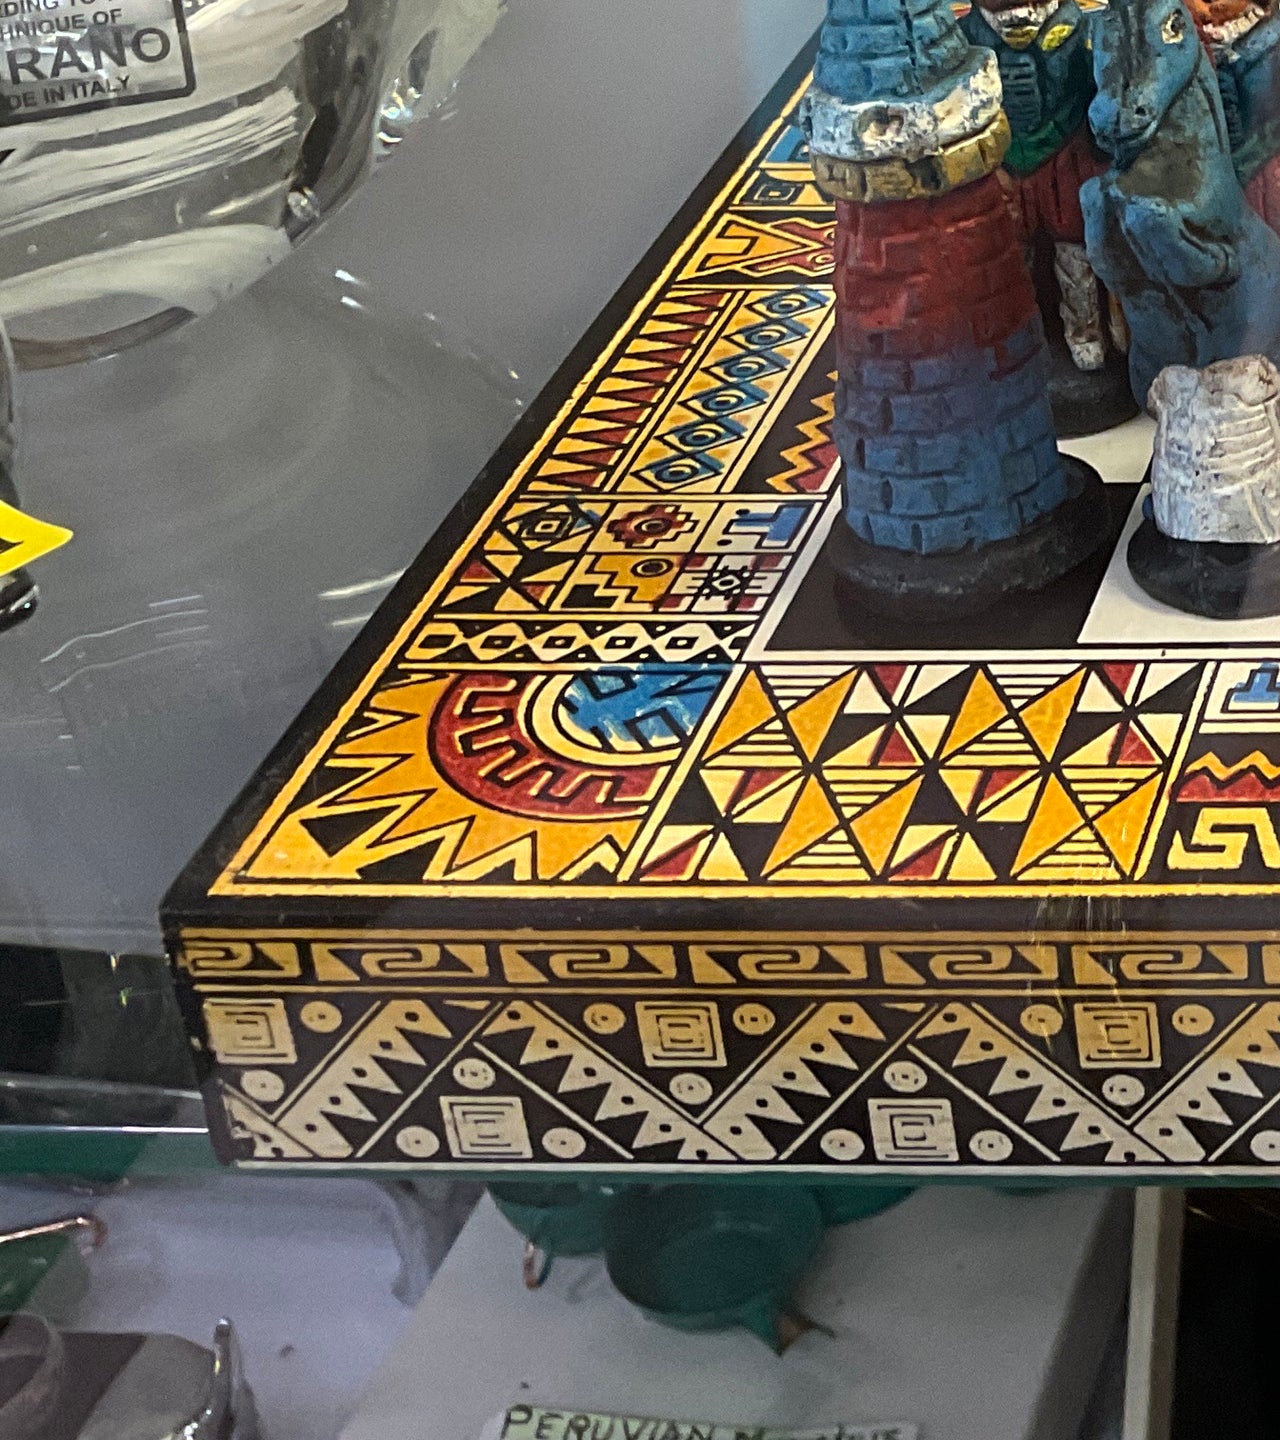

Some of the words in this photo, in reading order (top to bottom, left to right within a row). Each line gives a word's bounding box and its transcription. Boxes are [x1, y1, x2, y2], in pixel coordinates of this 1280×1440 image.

[93, 8, 122, 26] OF
[44, 85, 66, 103] IN
[72, 75, 130, 98] ITALY
